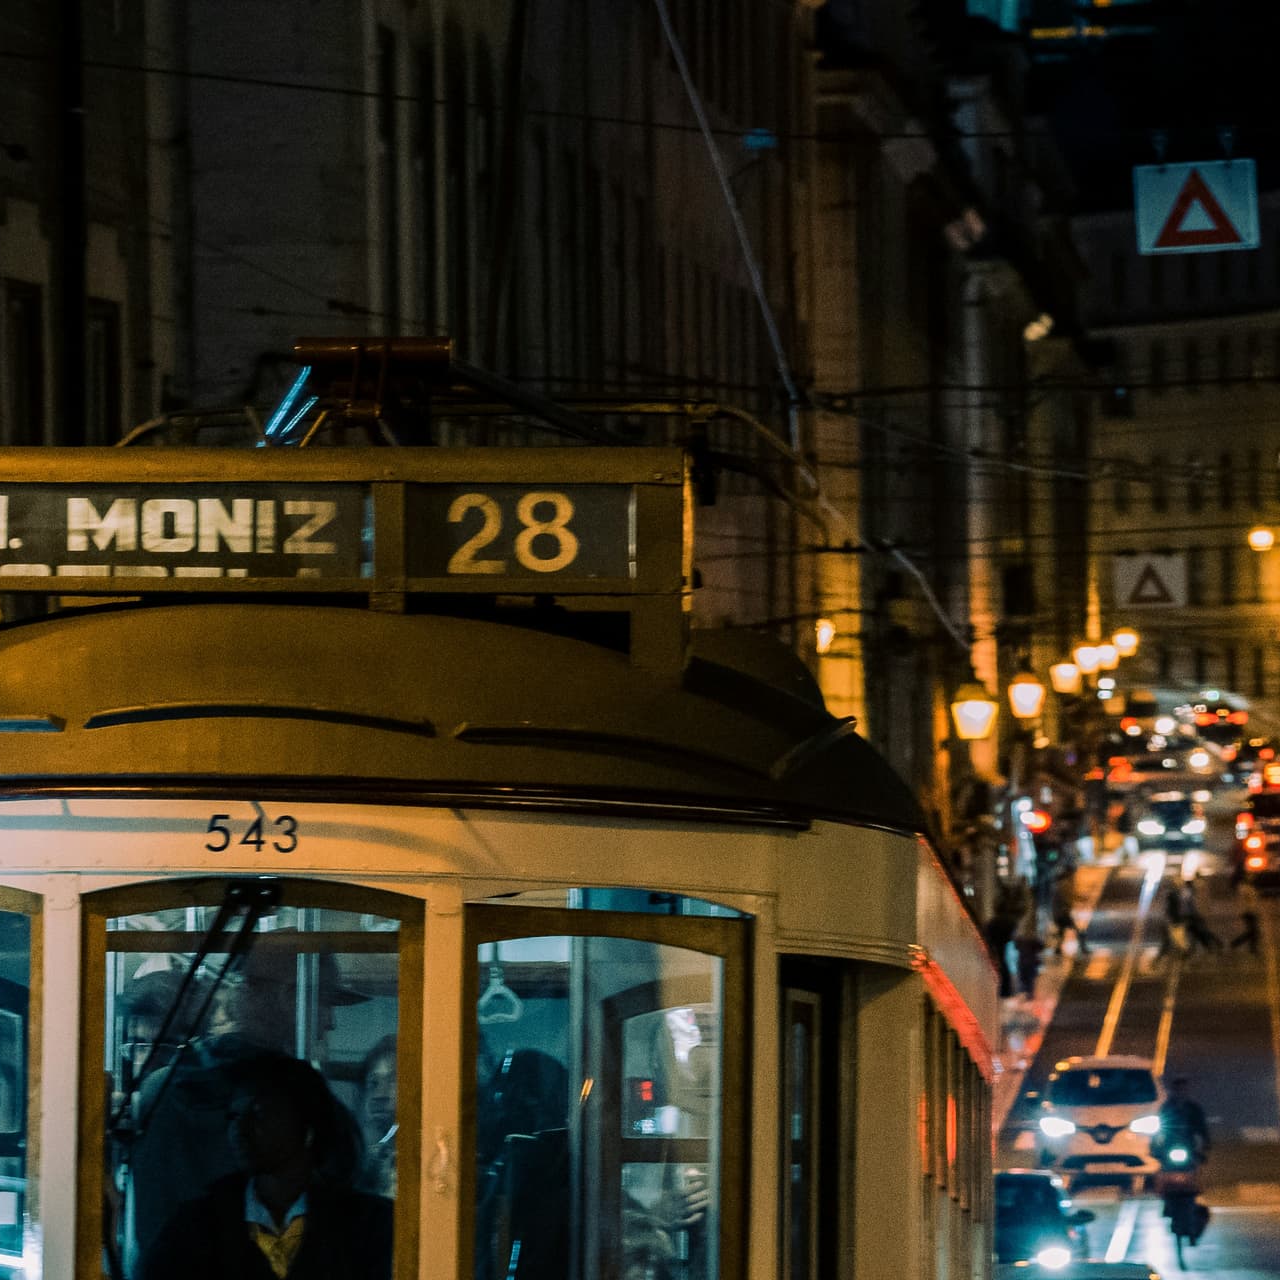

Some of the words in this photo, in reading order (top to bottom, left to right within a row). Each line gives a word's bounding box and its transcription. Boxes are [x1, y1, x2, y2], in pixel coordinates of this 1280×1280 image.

[67, 497, 337, 554] MONIZ
[447, 491, 580, 575] 28
[205, 814, 299, 854] 543
